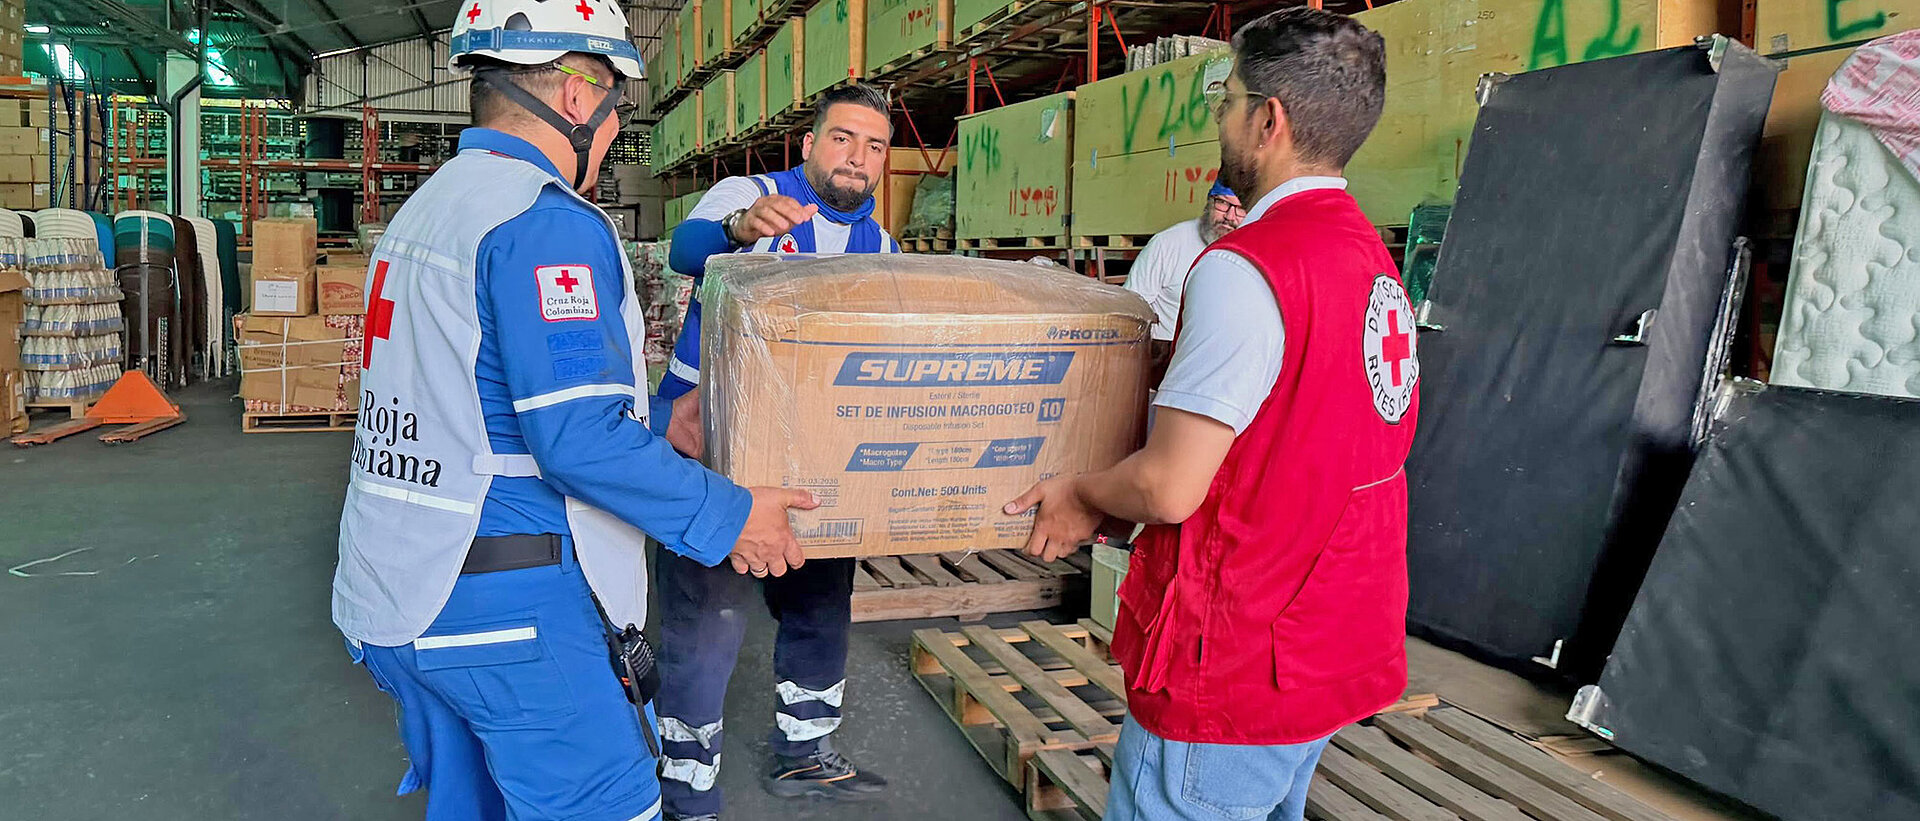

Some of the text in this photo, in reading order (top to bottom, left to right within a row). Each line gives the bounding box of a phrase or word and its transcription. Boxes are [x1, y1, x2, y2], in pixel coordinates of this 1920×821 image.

[966, 123, 999, 176] V46
[547, 295, 590, 305] Cruz Roja
[546, 306, 594, 317] Colombiana
[856, 358, 1047, 381] SUPREME
[1368, 354, 1395, 417] ROTES
[361, 389, 419, 446] Roja
[836, 402, 1060, 418] SET DE INFUSION MACROGOTEO 10
[972, 421, 984, 429] Set
[892, 485, 987, 498] Cont.Net: 500 Units
